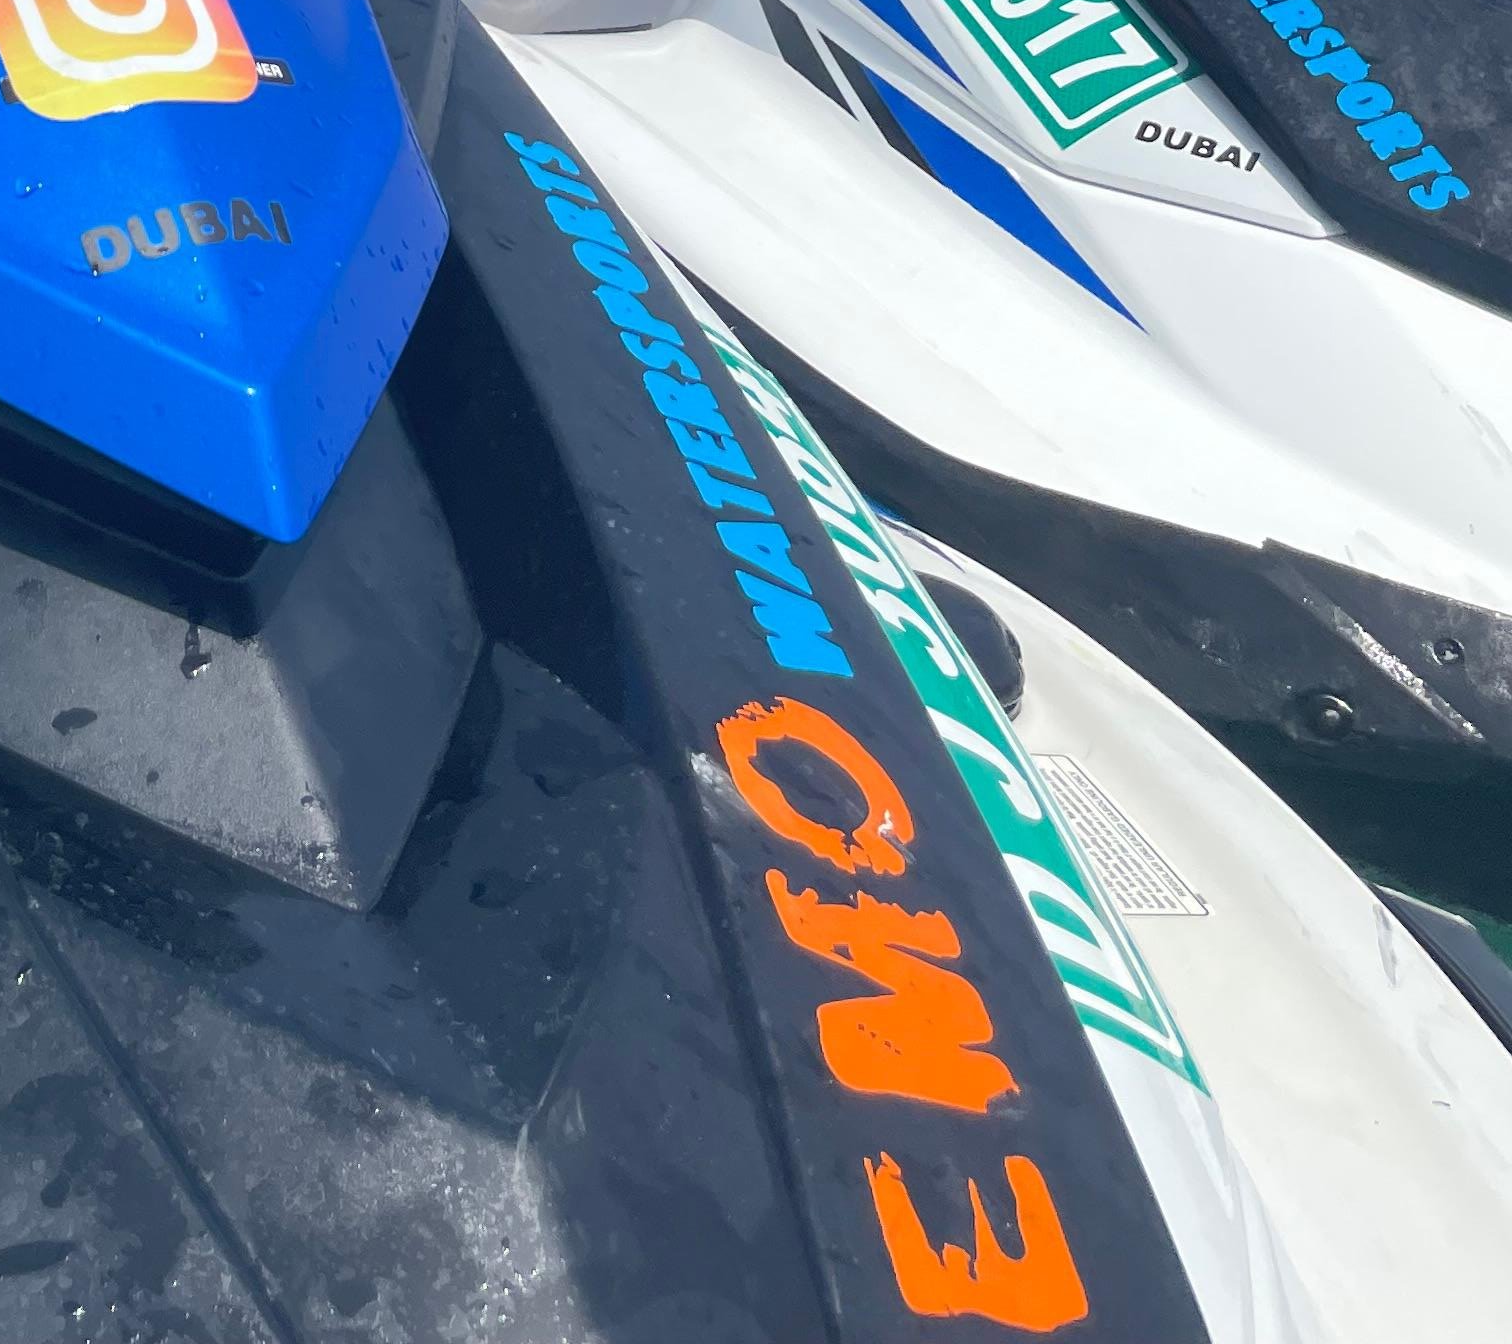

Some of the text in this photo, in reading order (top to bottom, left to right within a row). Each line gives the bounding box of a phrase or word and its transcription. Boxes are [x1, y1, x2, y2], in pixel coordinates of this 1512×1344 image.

[1135, 121, 1261, 172] DUBAI
[81, 198, 291, 275] DUBAI
[504, 130, 854, 678] WATERSPORTS
